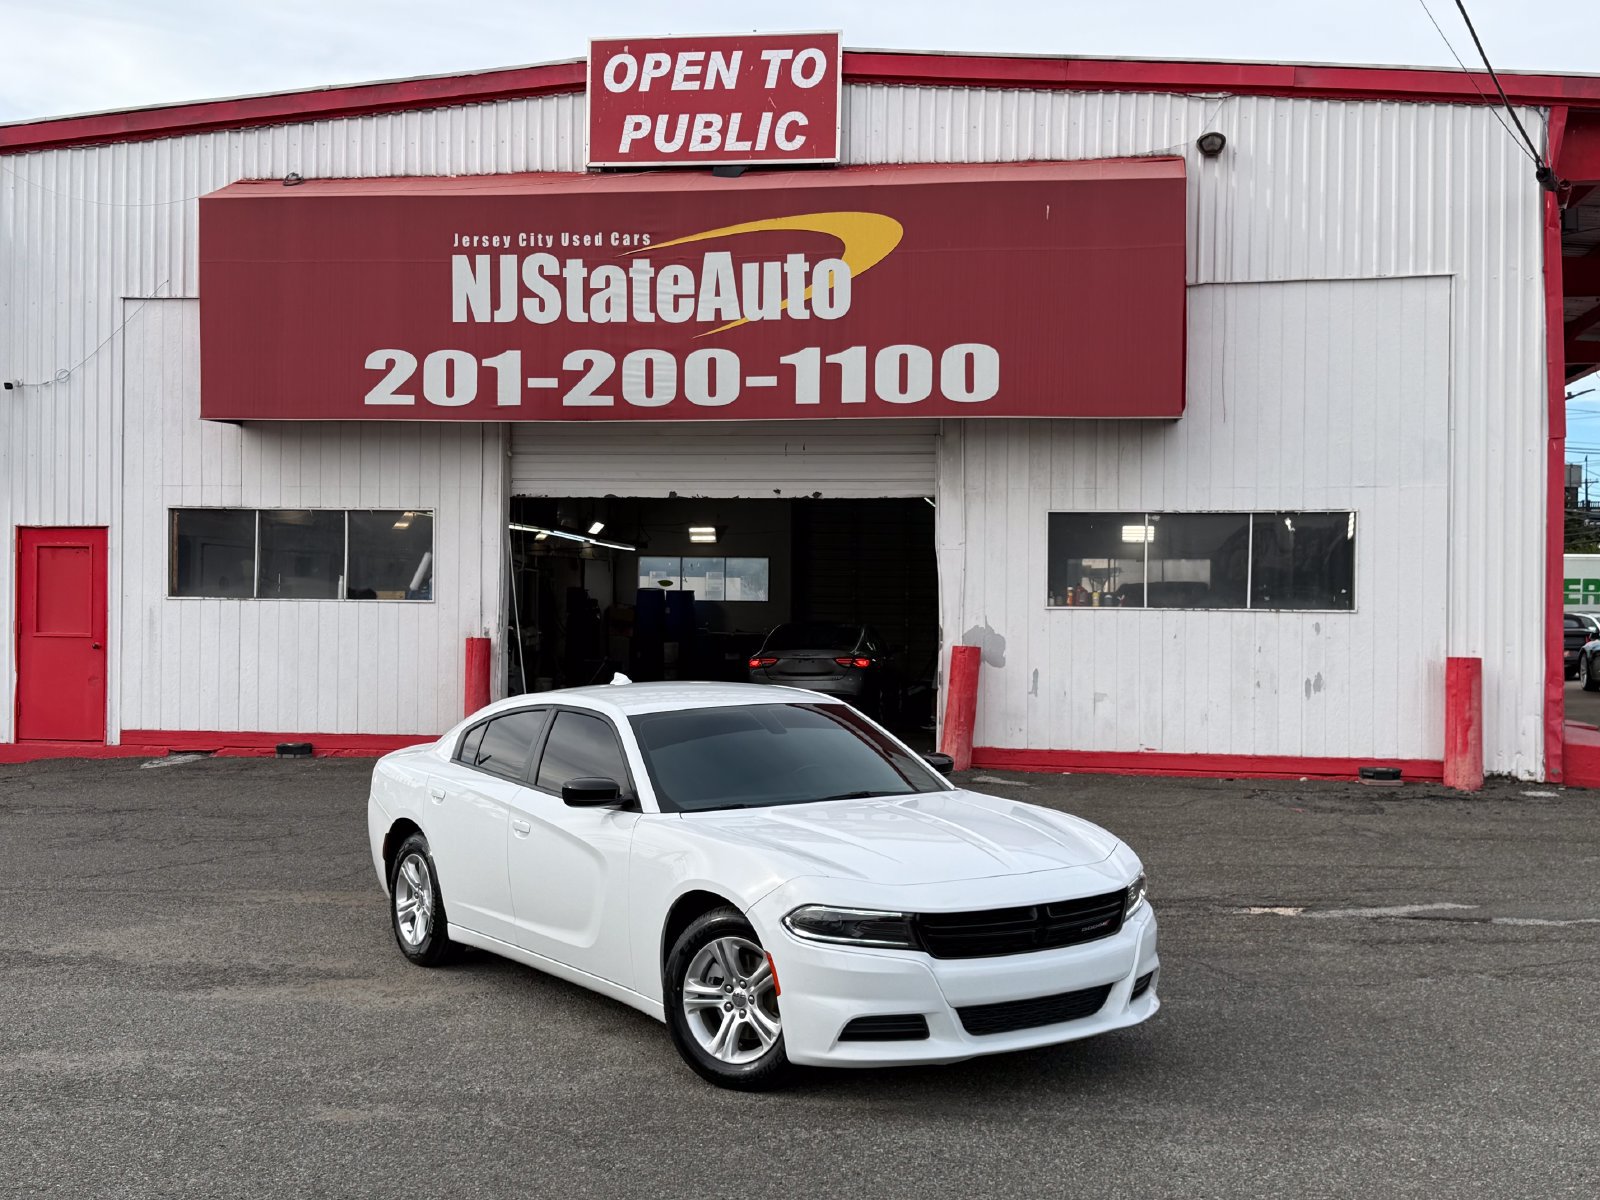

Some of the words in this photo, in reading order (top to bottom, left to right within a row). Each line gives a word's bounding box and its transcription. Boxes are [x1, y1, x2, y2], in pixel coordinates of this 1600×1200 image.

[603, 51, 743, 93] OPEN
[760, 48, 827, 89] TO
[618, 111, 809, 154] PUBLIC
[453, 233, 511, 248] Jersey
[518, 233, 554, 248] City
[561, 232, 603, 247] Used
[610, 231, 651, 247] Cars
[451, 251, 853, 324] NJStateAuto
[364, 342, 1000, 407] 201-200-1100
